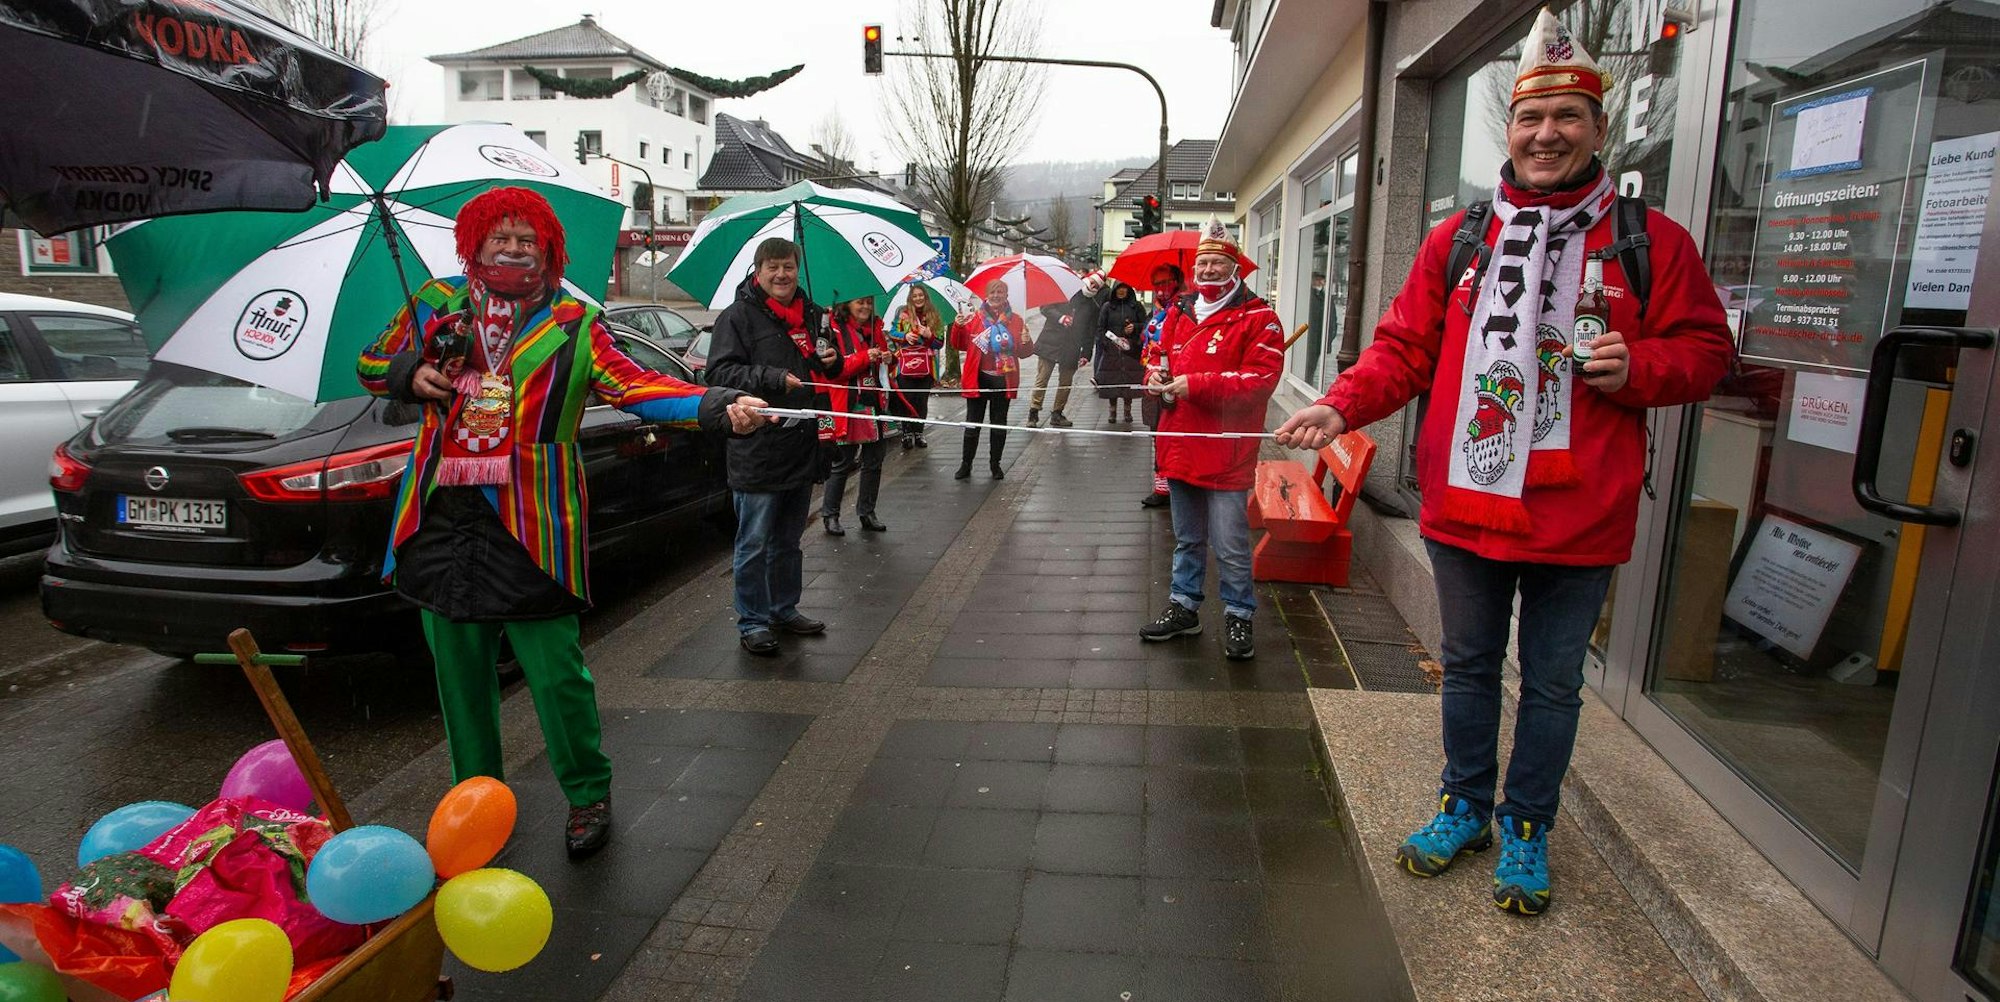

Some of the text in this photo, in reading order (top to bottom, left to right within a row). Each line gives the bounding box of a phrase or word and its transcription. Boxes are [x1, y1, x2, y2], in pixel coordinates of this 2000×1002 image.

[134, 11, 259, 65] VODKA
[1931, 147, 1995, 166] Liebe Kund
[1775, 184, 1880, 208] Öffnungszeiten:
[1789, 231, 1804, 241] 9.30
[1812, 230, 1832, 240] 12.00
[1834, 229, 1849, 238] Uhr
[1783, 243, 1803, 253] 14.00
[1810, 242, 1830, 252] 18.00
[1832, 242, 1847, 251] Uhr
[1783, 274, 1799, 283] 9.00
[1805, 274, 1826, 283] 12.00
[1827, 274, 1842, 283] Uhr
[1912, 282, 1971, 293] Vielen Dan
[1777, 303, 1840, 315] Terminabsprache:
[1774, 315, 1791, 323] 0160
[1797, 316, 1810, 325] 937
[1813, 317, 1826, 326] 331
[1828, 318, 1838, 327] 51
[1801, 396, 1850, 415] DRÜCKEN.
[129, 499, 224, 524] GM PK 1313
